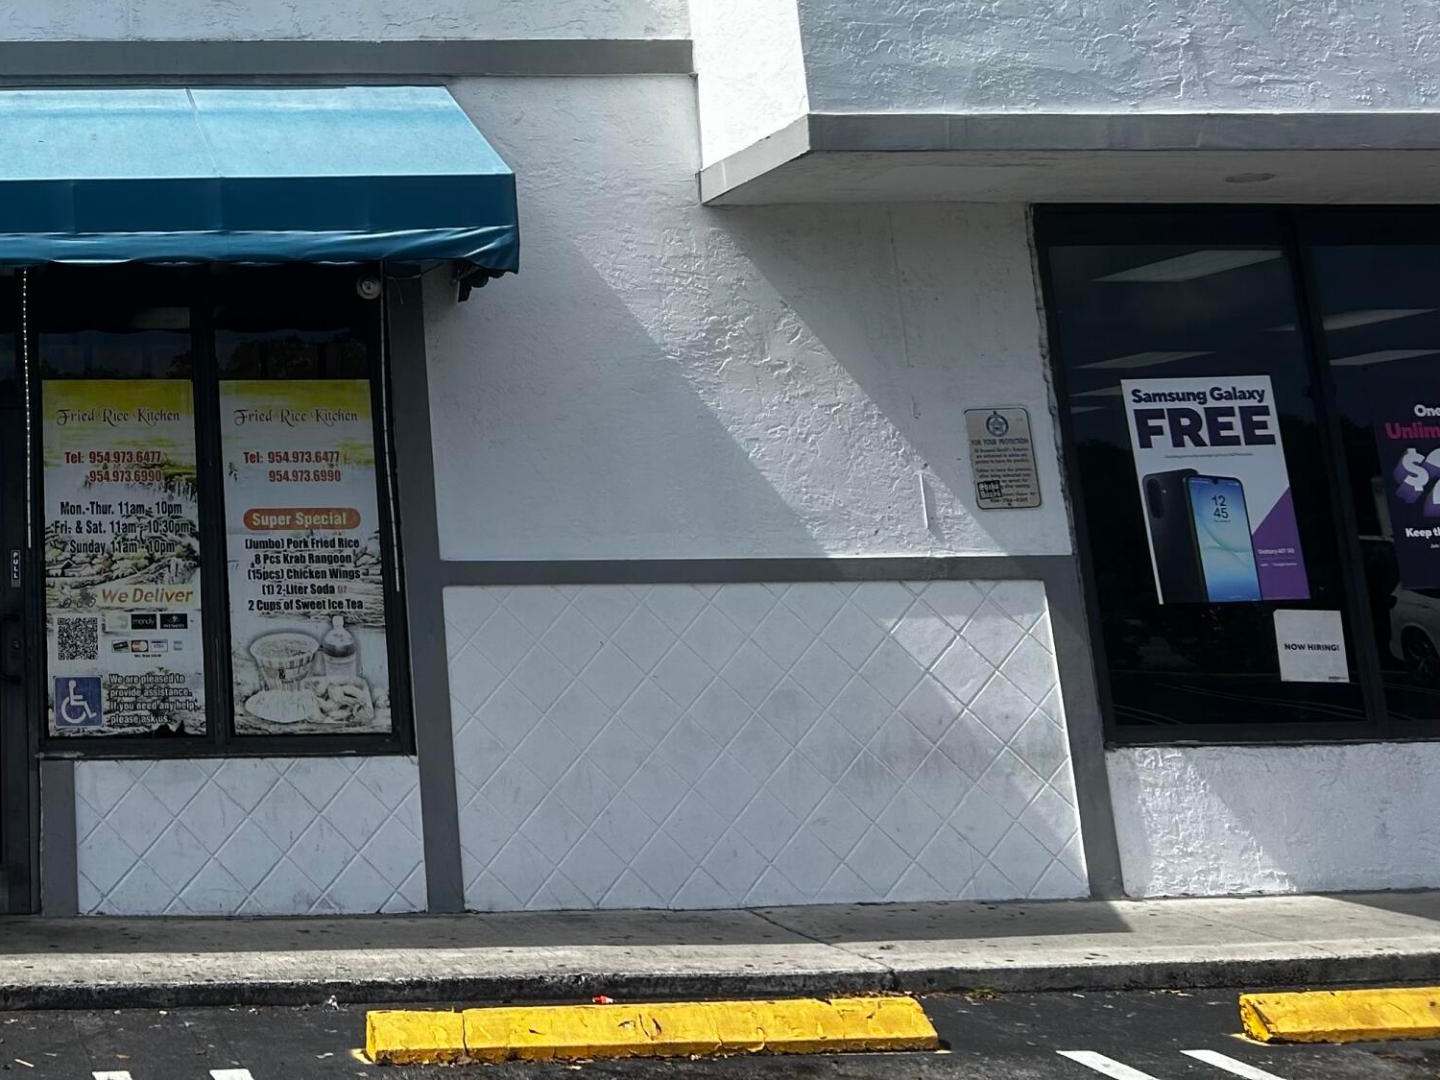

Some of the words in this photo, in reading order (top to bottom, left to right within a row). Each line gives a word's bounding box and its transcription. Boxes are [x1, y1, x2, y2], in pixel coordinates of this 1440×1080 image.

[1131, 388, 1207, 405] Samsung
[1210, 387, 1265, 403] Galaxy
[56, 408, 95, 426] Fried
[102, 408, 129, 427] Rice
[137, 408, 180, 426] Kitchen
[233, 409, 272, 426] Fried
[280, 408, 307, 427] Rice
[315, 408, 358, 426] Kitchen
[1133, 406, 1276, 449] FREE
[65, 452, 84, 464] Tel:
[89, 451, 161, 464] 954.973.6477
[243, 452, 263, 464] Tel:
[267, 451, 340, 464] 954.973.6477
[89, 470, 161, 482] 954.973.6990
[269, 470, 341, 482] 954.973.6990
[1212, 495, 1227, 507] 12
[60, 502, 114, 516] Mon.-Thur.
[118, 502, 145, 515] 11am
[155, 501, 182, 518] 10pm
[1213, 508, 1229, 520] 45
[252, 513, 291, 529] Super
[295, 512, 346, 528] Special
[54, 522, 72, 534] Fri.
[75, 522, 83, 534] &
[86, 522, 106, 534] Sat.
[110, 522, 136, 534] 11am
[148, 521, 190, 537] 10:30pm
[1405, 527, 1432, 539] Keep
[70, 540, 106, 556] Sunday
[111, 540, 137, 553] 11am
[148, 540, 176, 556] 10pm
[245, 539, 284, 550] (Jumbo)
[287, 538, 309, 549] Pork
[311, 538, 336, 548] Fried
[338, 538, 359, 548] Rice
[254, 554, 260, 564] 8
[263, 554, 281, 564] Pcs
[283, 553, 306, 564] Krab
[309, 554, 352, 566] Rangoon
[248, 569, 285, 581] (15pcs)
[287, 569, 327, 579] Chicken
[329, 569, 360, 581] Wings
[102, 589, 127, 603] We
[132, 588, 193, 603] Deliver
[276, 584, 308, 595] 2-Liter
[310, 584, 335, 594] Soda
[248, 600, 254, 611] 2
[257, 600, 281, 612] Cups
[284, 600, 294, 610] of
[295, 600, 326, 610] Sweet
[327, 600, 344, 610] Ice
[346, 599, 363, 610] Tea
[1284, 643, 1305, 651] NOW
[1307, 643, 1340, 651] HIRING!
[109, 674, 123, 684] We
[125, 675, 139, 684] are
[140, 673, 174, 686] pleased
[176, 673, 185, 684] to
[110, 687, 141, 699] provide
[143, 688, 192, 698] assistance.
[110, 701, 118, 710] If
[119, 702, 135, 712] you
[136, 701, 157, 710] need
[159, 701, 174, 712] any
[110, 715, 139, 726] please
[141, 714, 156, 724] ask
